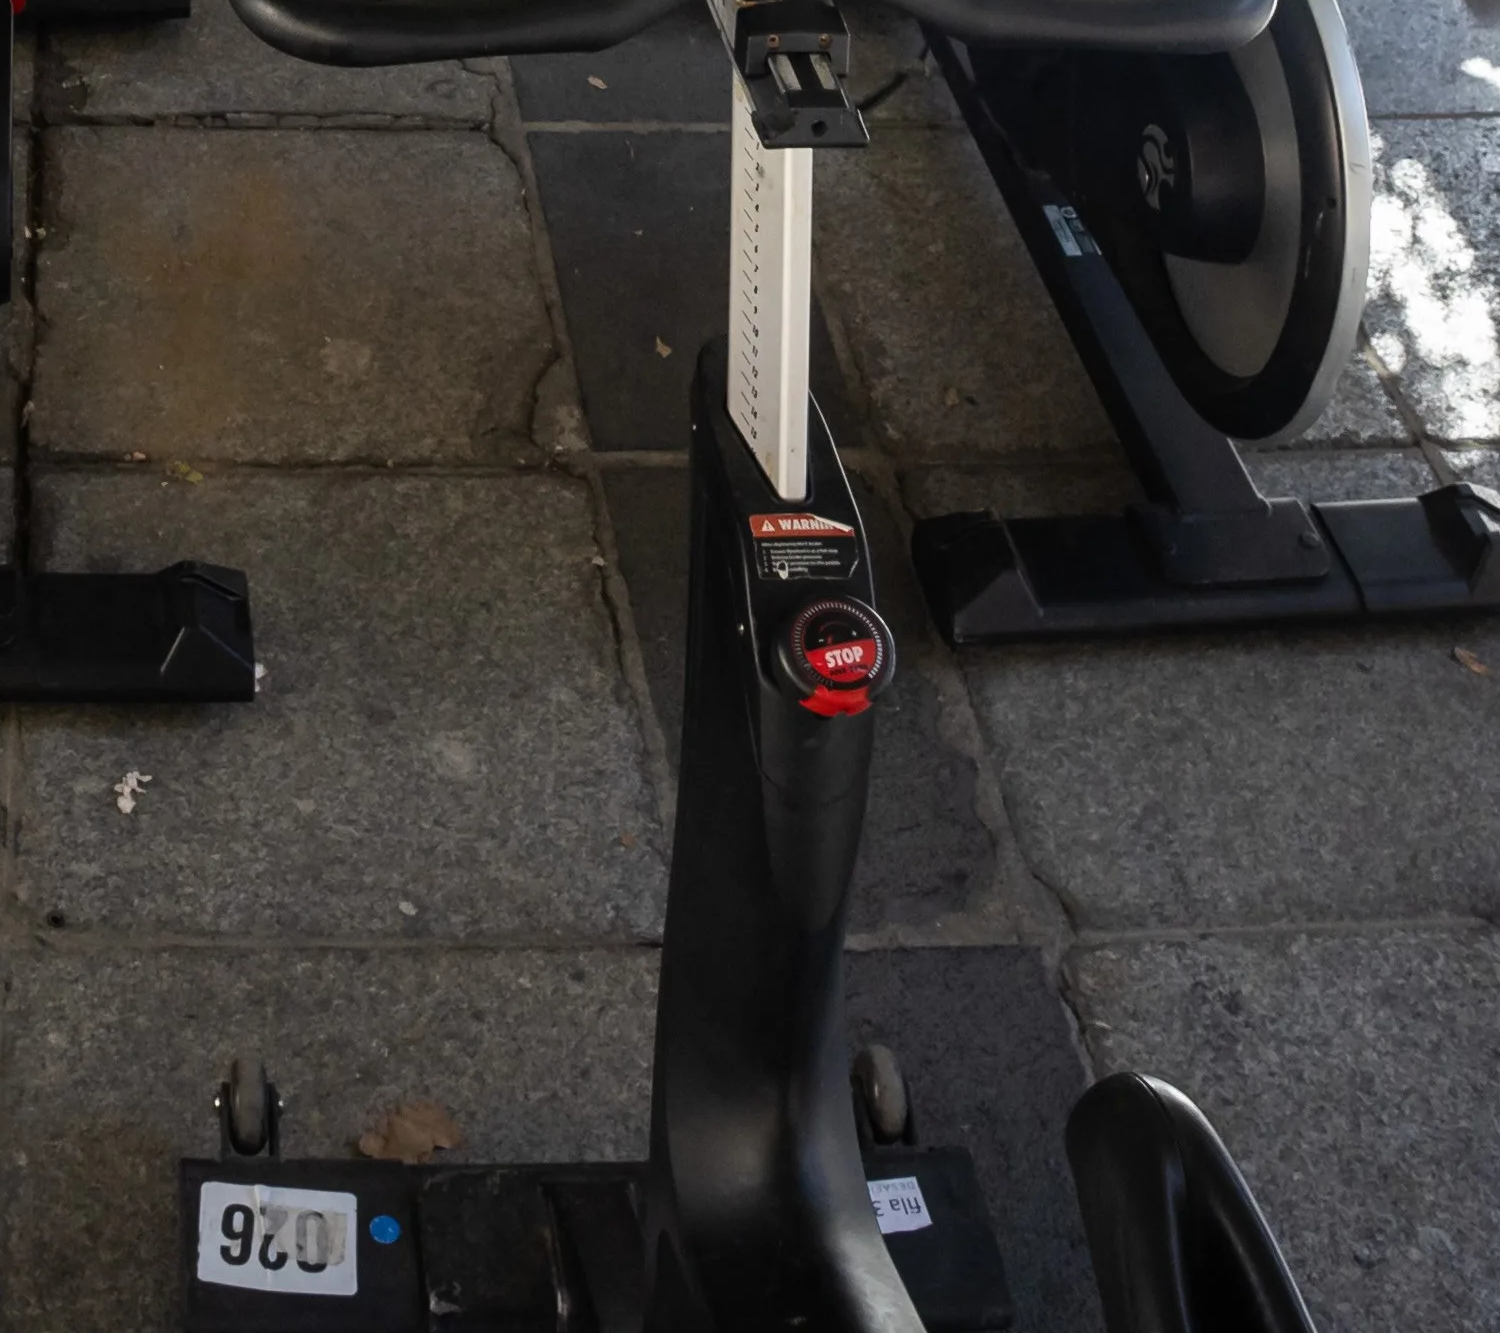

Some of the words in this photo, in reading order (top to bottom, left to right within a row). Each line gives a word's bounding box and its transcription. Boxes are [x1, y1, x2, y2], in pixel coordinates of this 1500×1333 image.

[824, 645, 865, 670] STOP
[888, 1196, 923, 1217] fila
[219, 1203, 329, 1274] 026
